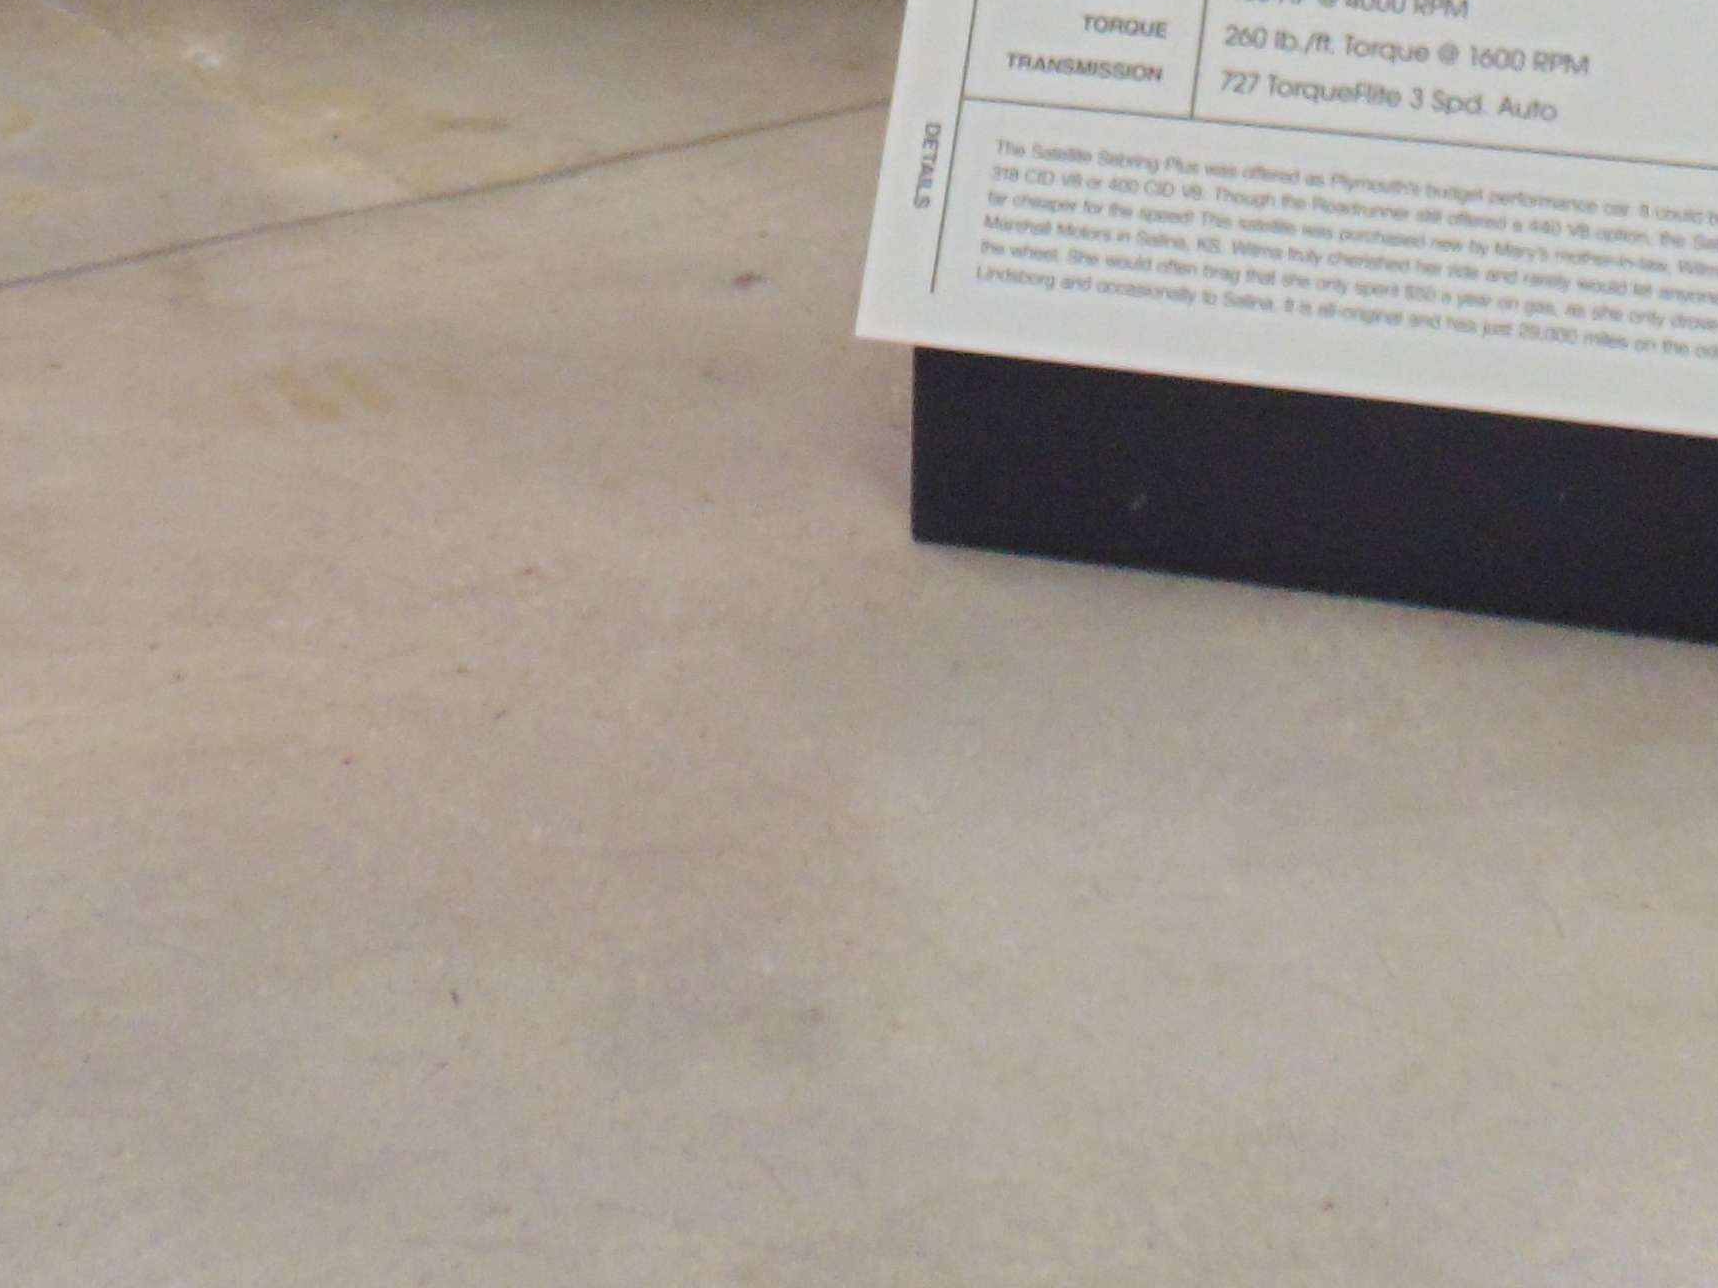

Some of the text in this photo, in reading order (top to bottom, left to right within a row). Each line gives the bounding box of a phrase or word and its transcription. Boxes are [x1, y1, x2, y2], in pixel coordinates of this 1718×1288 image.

[1082, 13, 1168, 39] TORQUE
[1223, 22, 1268, 49] 260
[1344, 33, 1430, 63] Torque
[1436, 41, 1460, 66] @
[1469, 44, 1526, 72] 1600
[1531, 49, 1590, 75] RPM
[1007, 51, 1163, 82] TRANSMISSION
[1220, 68, 1558, 122] 727 TorqueFlite 3 Spd. Auto
[911, 120, 942, 209] DETAILS
